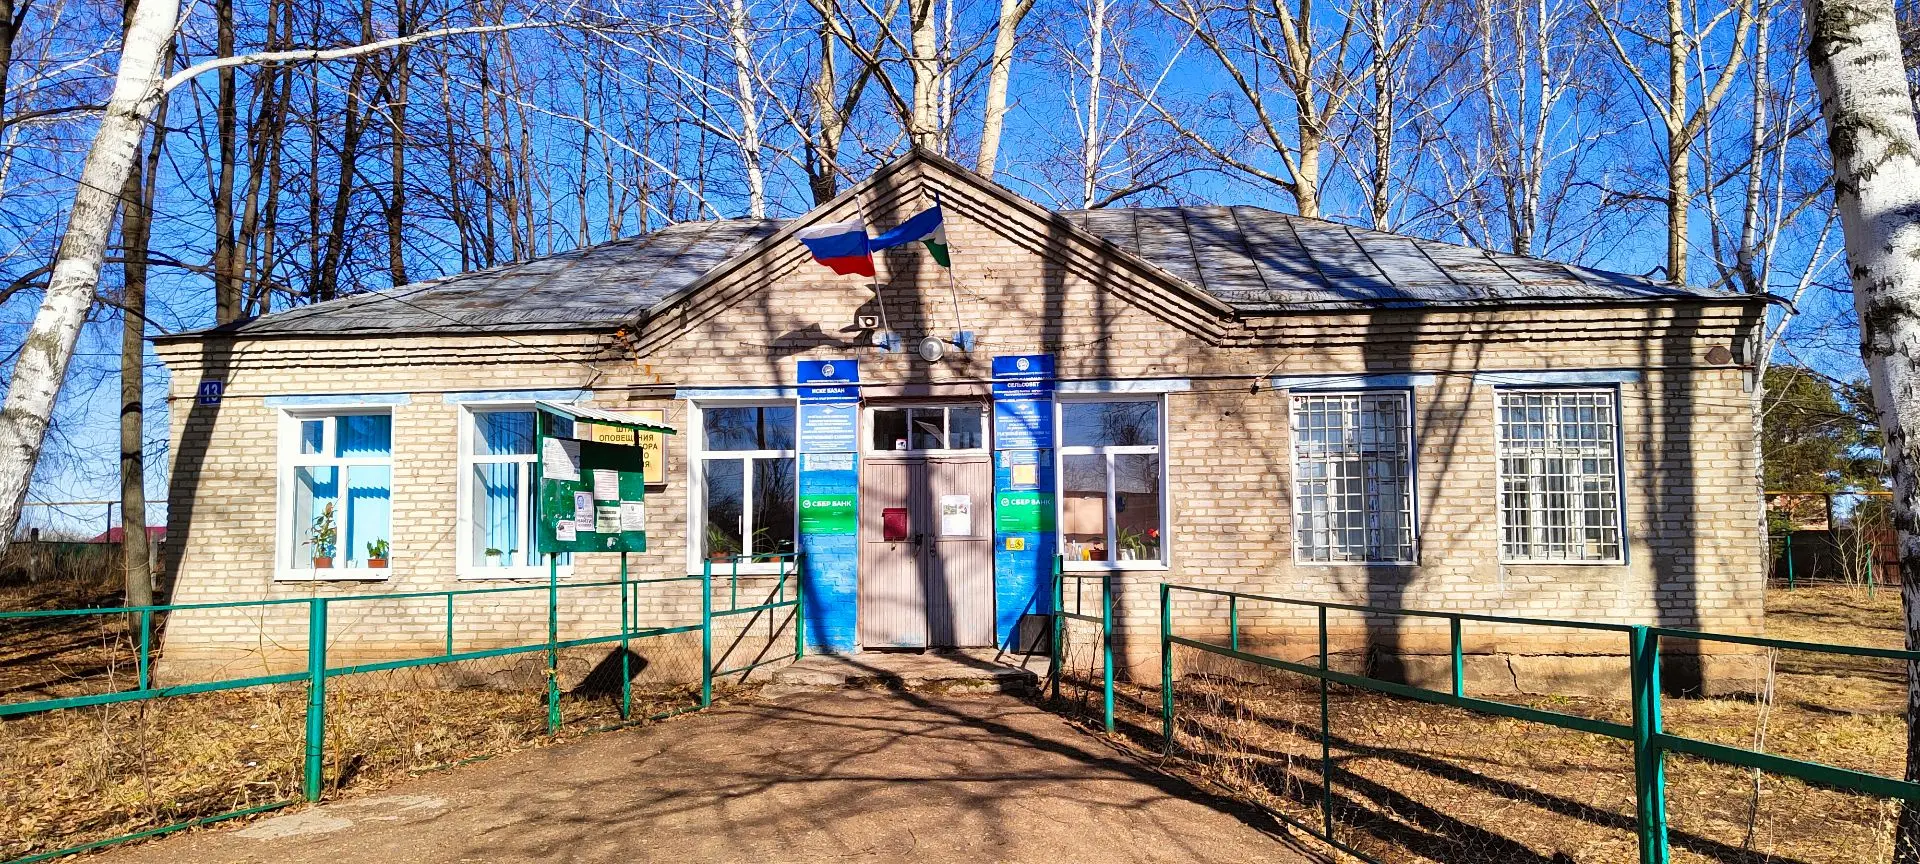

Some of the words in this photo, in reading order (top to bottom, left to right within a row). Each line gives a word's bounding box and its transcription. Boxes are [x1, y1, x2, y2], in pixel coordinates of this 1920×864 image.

[204, 384, 218, 401] 13
[599, 434, 654, 442] ОПОВЕЩНИЯ
[1011, 498, 1030, 506] СБЕР
[1031, 498, 1051, 506] БАНК
